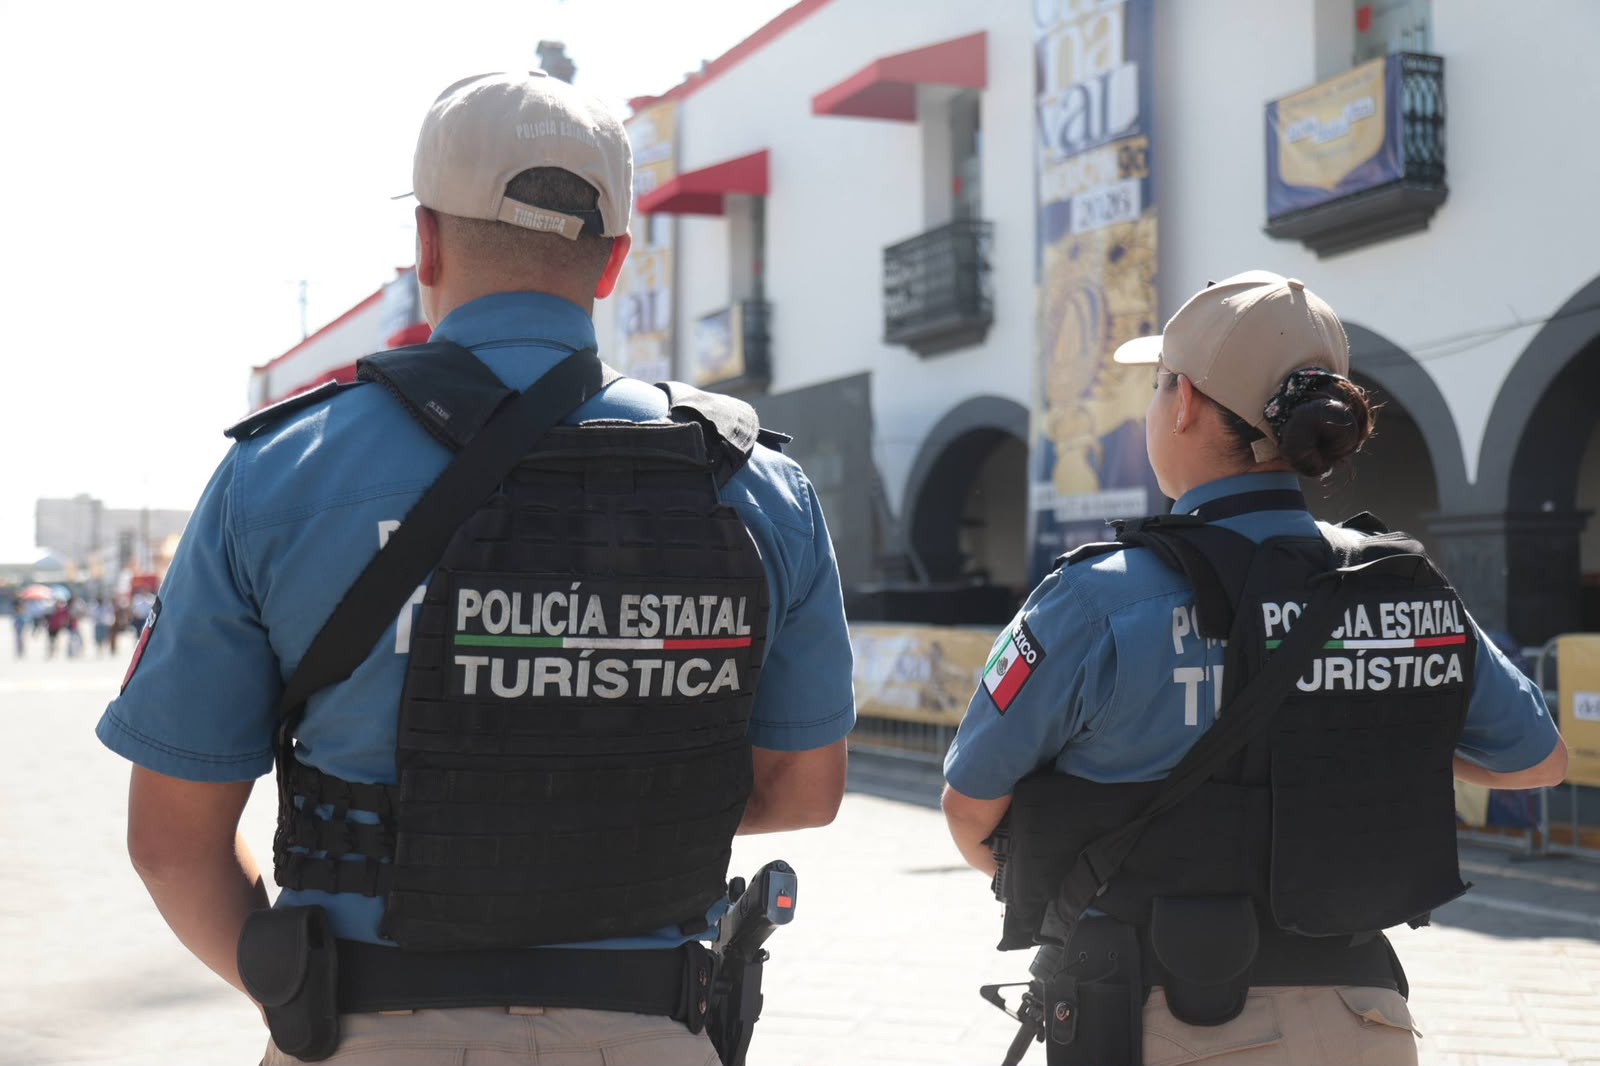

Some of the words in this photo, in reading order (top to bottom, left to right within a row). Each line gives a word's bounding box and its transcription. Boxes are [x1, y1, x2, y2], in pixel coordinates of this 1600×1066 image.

[515, 117, 557, 140] POLICÍA
[514, 206, 567, 233] TURÍSTICA
[457, 582, 607, 636] POLICÍA
[620, 594, 751, 637] ESTATAL
[1379, 600, 1465, 639] ESTATAL
[1011, 622, 1037, 665] ÉXICO
[454, 650, 741, 699] TURÍSTICA
[1296, 649, 1464, 692] URÍSTICA
